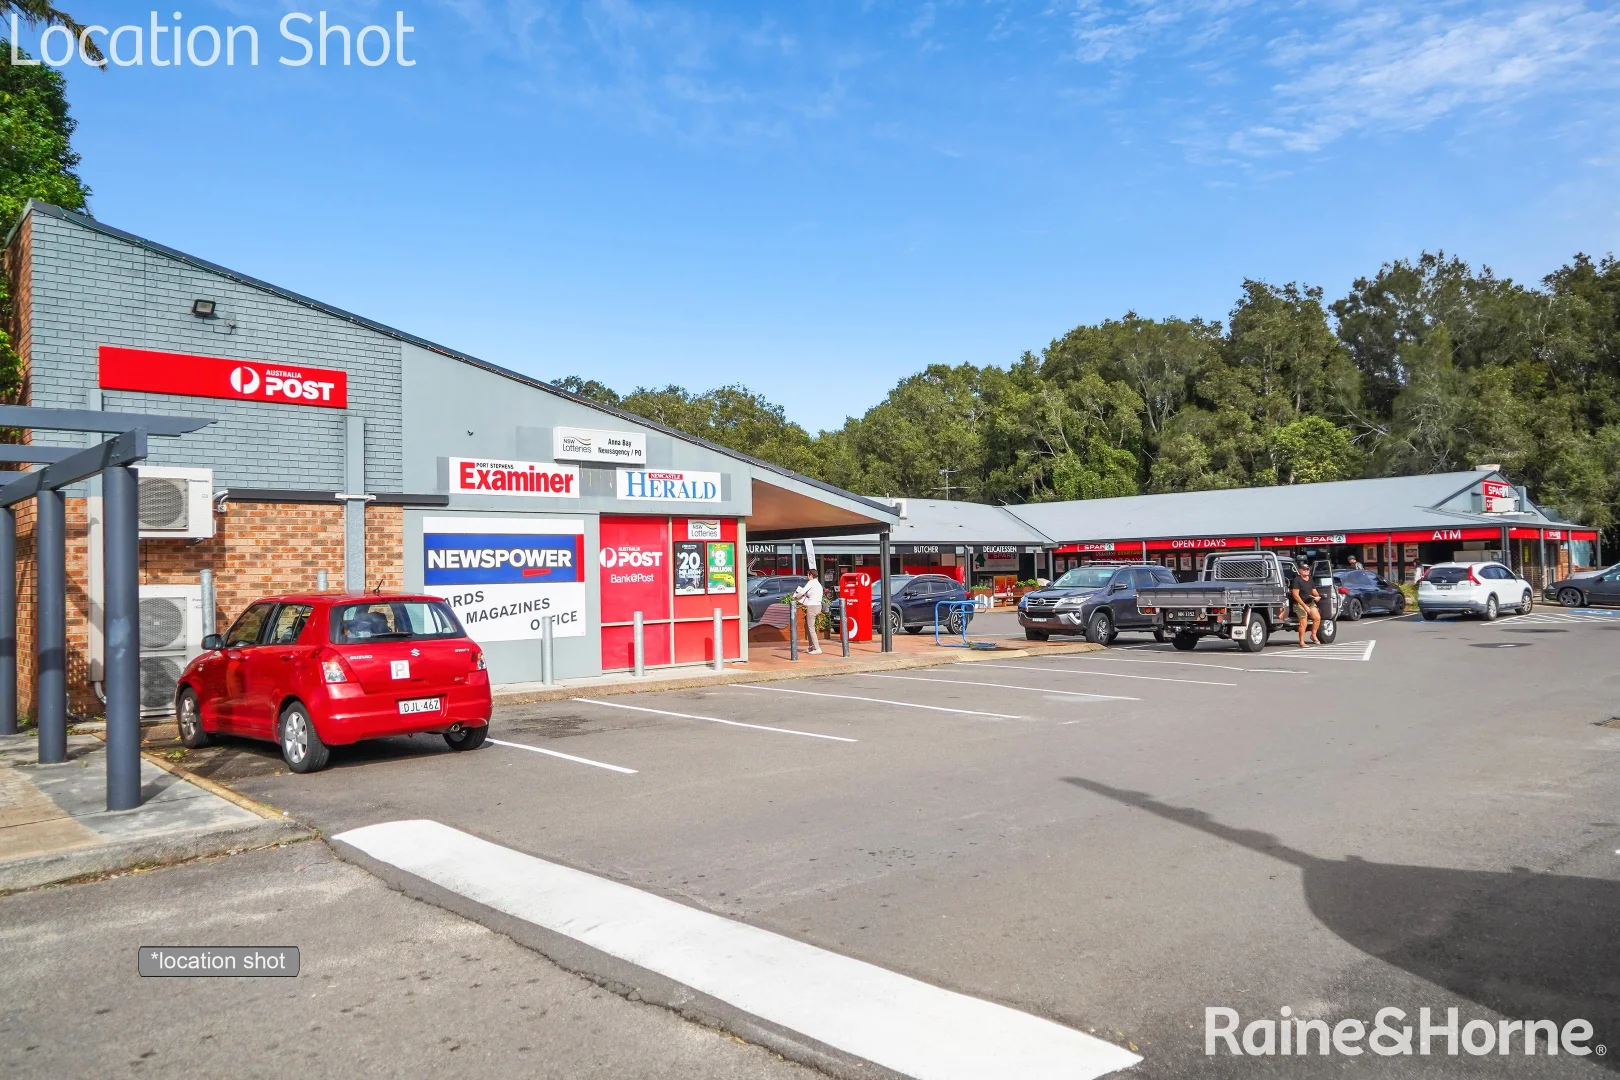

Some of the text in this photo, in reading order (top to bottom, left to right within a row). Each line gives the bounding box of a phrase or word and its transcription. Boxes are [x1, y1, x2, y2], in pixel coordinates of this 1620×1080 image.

[265, 368, 302, 379] AUSTRALIA
[264, 376, 335, 402] POST
[562, 443, 592, 453] Lotteries
[607, 438, 632, 448] Anna Bay
[598, 447, 630, 457] Newsagency
[460, 462, 574, 493] Examiner
[626, 471, 717, 500] HERALD
[691, 529, 718, 538] Lotteries
[1432, 529, 1462, 541] ATM
[1171, 538, 1226, 548] OPEN 7 DAYS
[913, 545, 939, 554] BUTCHER
[982, 545, 1017, 553] DELICATESSEN
[427, 547, 573, 570] NEWSPOWER
[618, 551, 663, 567] POST
[610, 573, 655, 584] Bank@Post
[466, 597, 551, 625] MAGAZINES
[530, 610, 578, 631] OFICE
